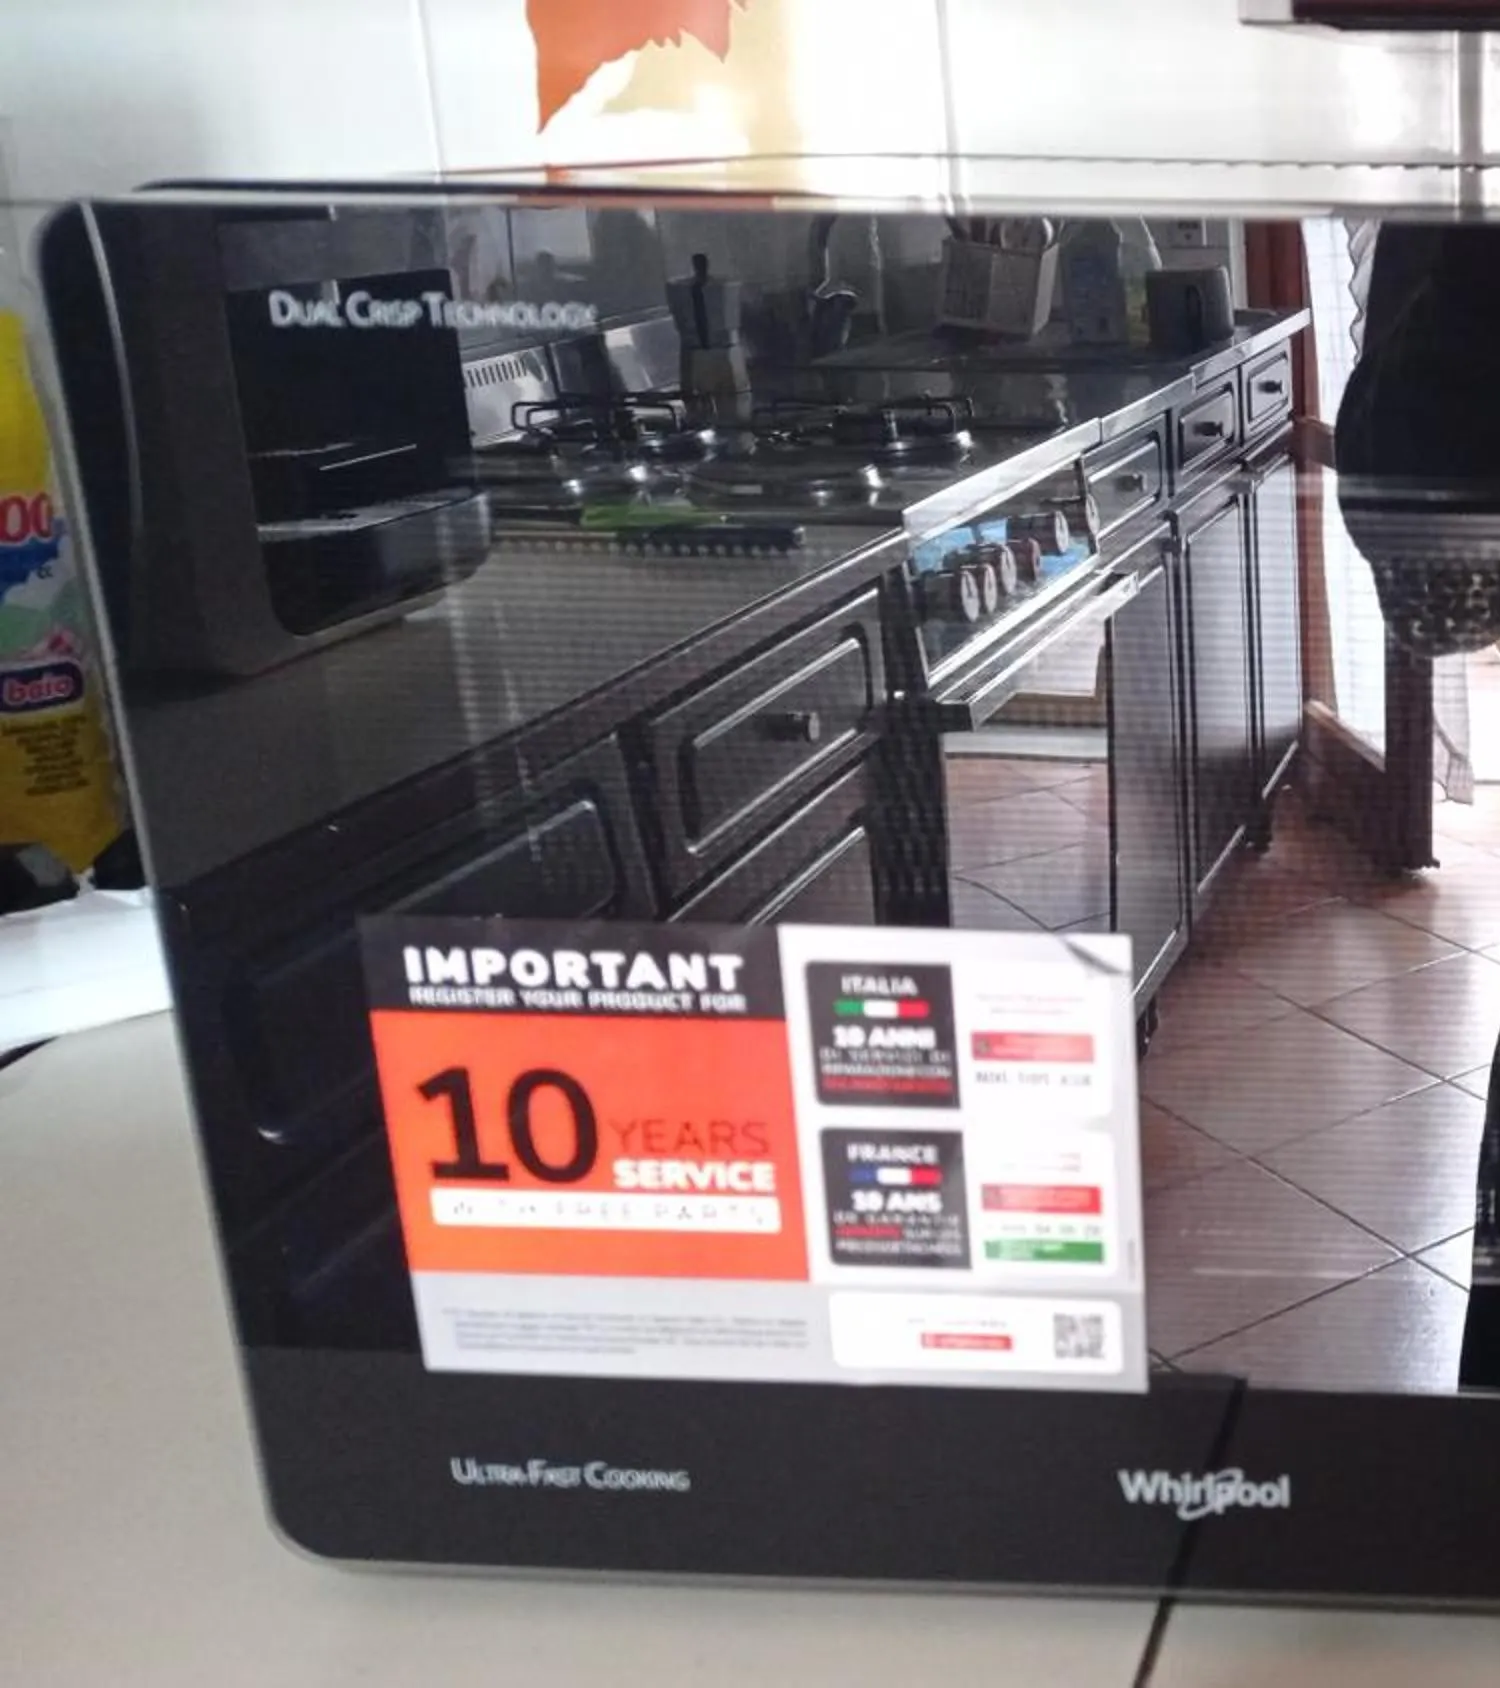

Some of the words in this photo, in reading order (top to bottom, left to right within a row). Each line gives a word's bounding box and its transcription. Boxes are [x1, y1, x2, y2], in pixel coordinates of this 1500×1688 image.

[268, 289, 345, 327] DUAL
[345, 291, 422, 327] CRISP
[403, 945, 744, 992] IMPORTANT
[840, 974, 917, 996] ITALIA
[409, 986, 515, 1009] REGISTER
[519, 990, 584, 1009] YOUR
[588, 991, 693, 1012] PRODUCT
[700, 994, 747, 1013] FOR
[416, 1066, 600, 1184] 10
[608, 1119, 770, 1155] YEARS
[847, 1144, 939, 1164] FRANCE
[612, 1158, 777, 1192] SERVICE
[583, 1461, 692, 1491] COOKING
[1117, 1467, 1291, 1521] Whirlpool
